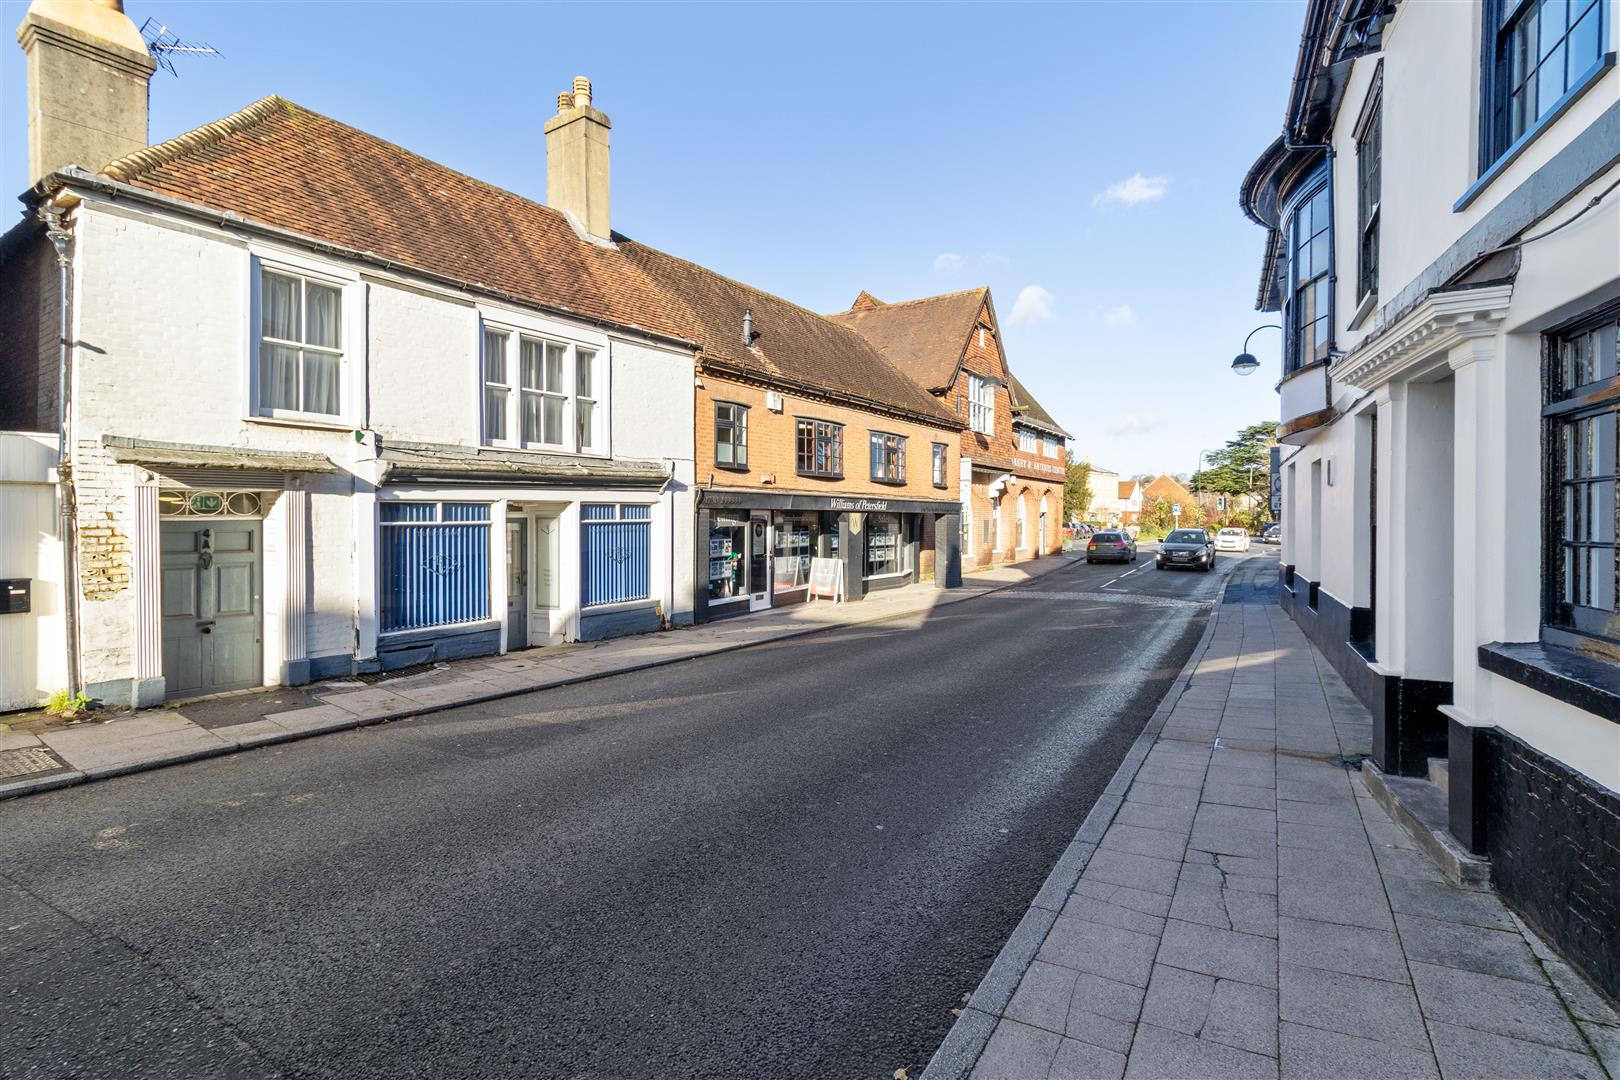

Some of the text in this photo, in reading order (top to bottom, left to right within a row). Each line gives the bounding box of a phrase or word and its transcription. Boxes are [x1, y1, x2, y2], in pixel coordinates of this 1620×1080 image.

[830, 498, 888, 510] Williams of Petersfield
[202, 528, 210, 538] 4
[202, 539, 210, 549] A
